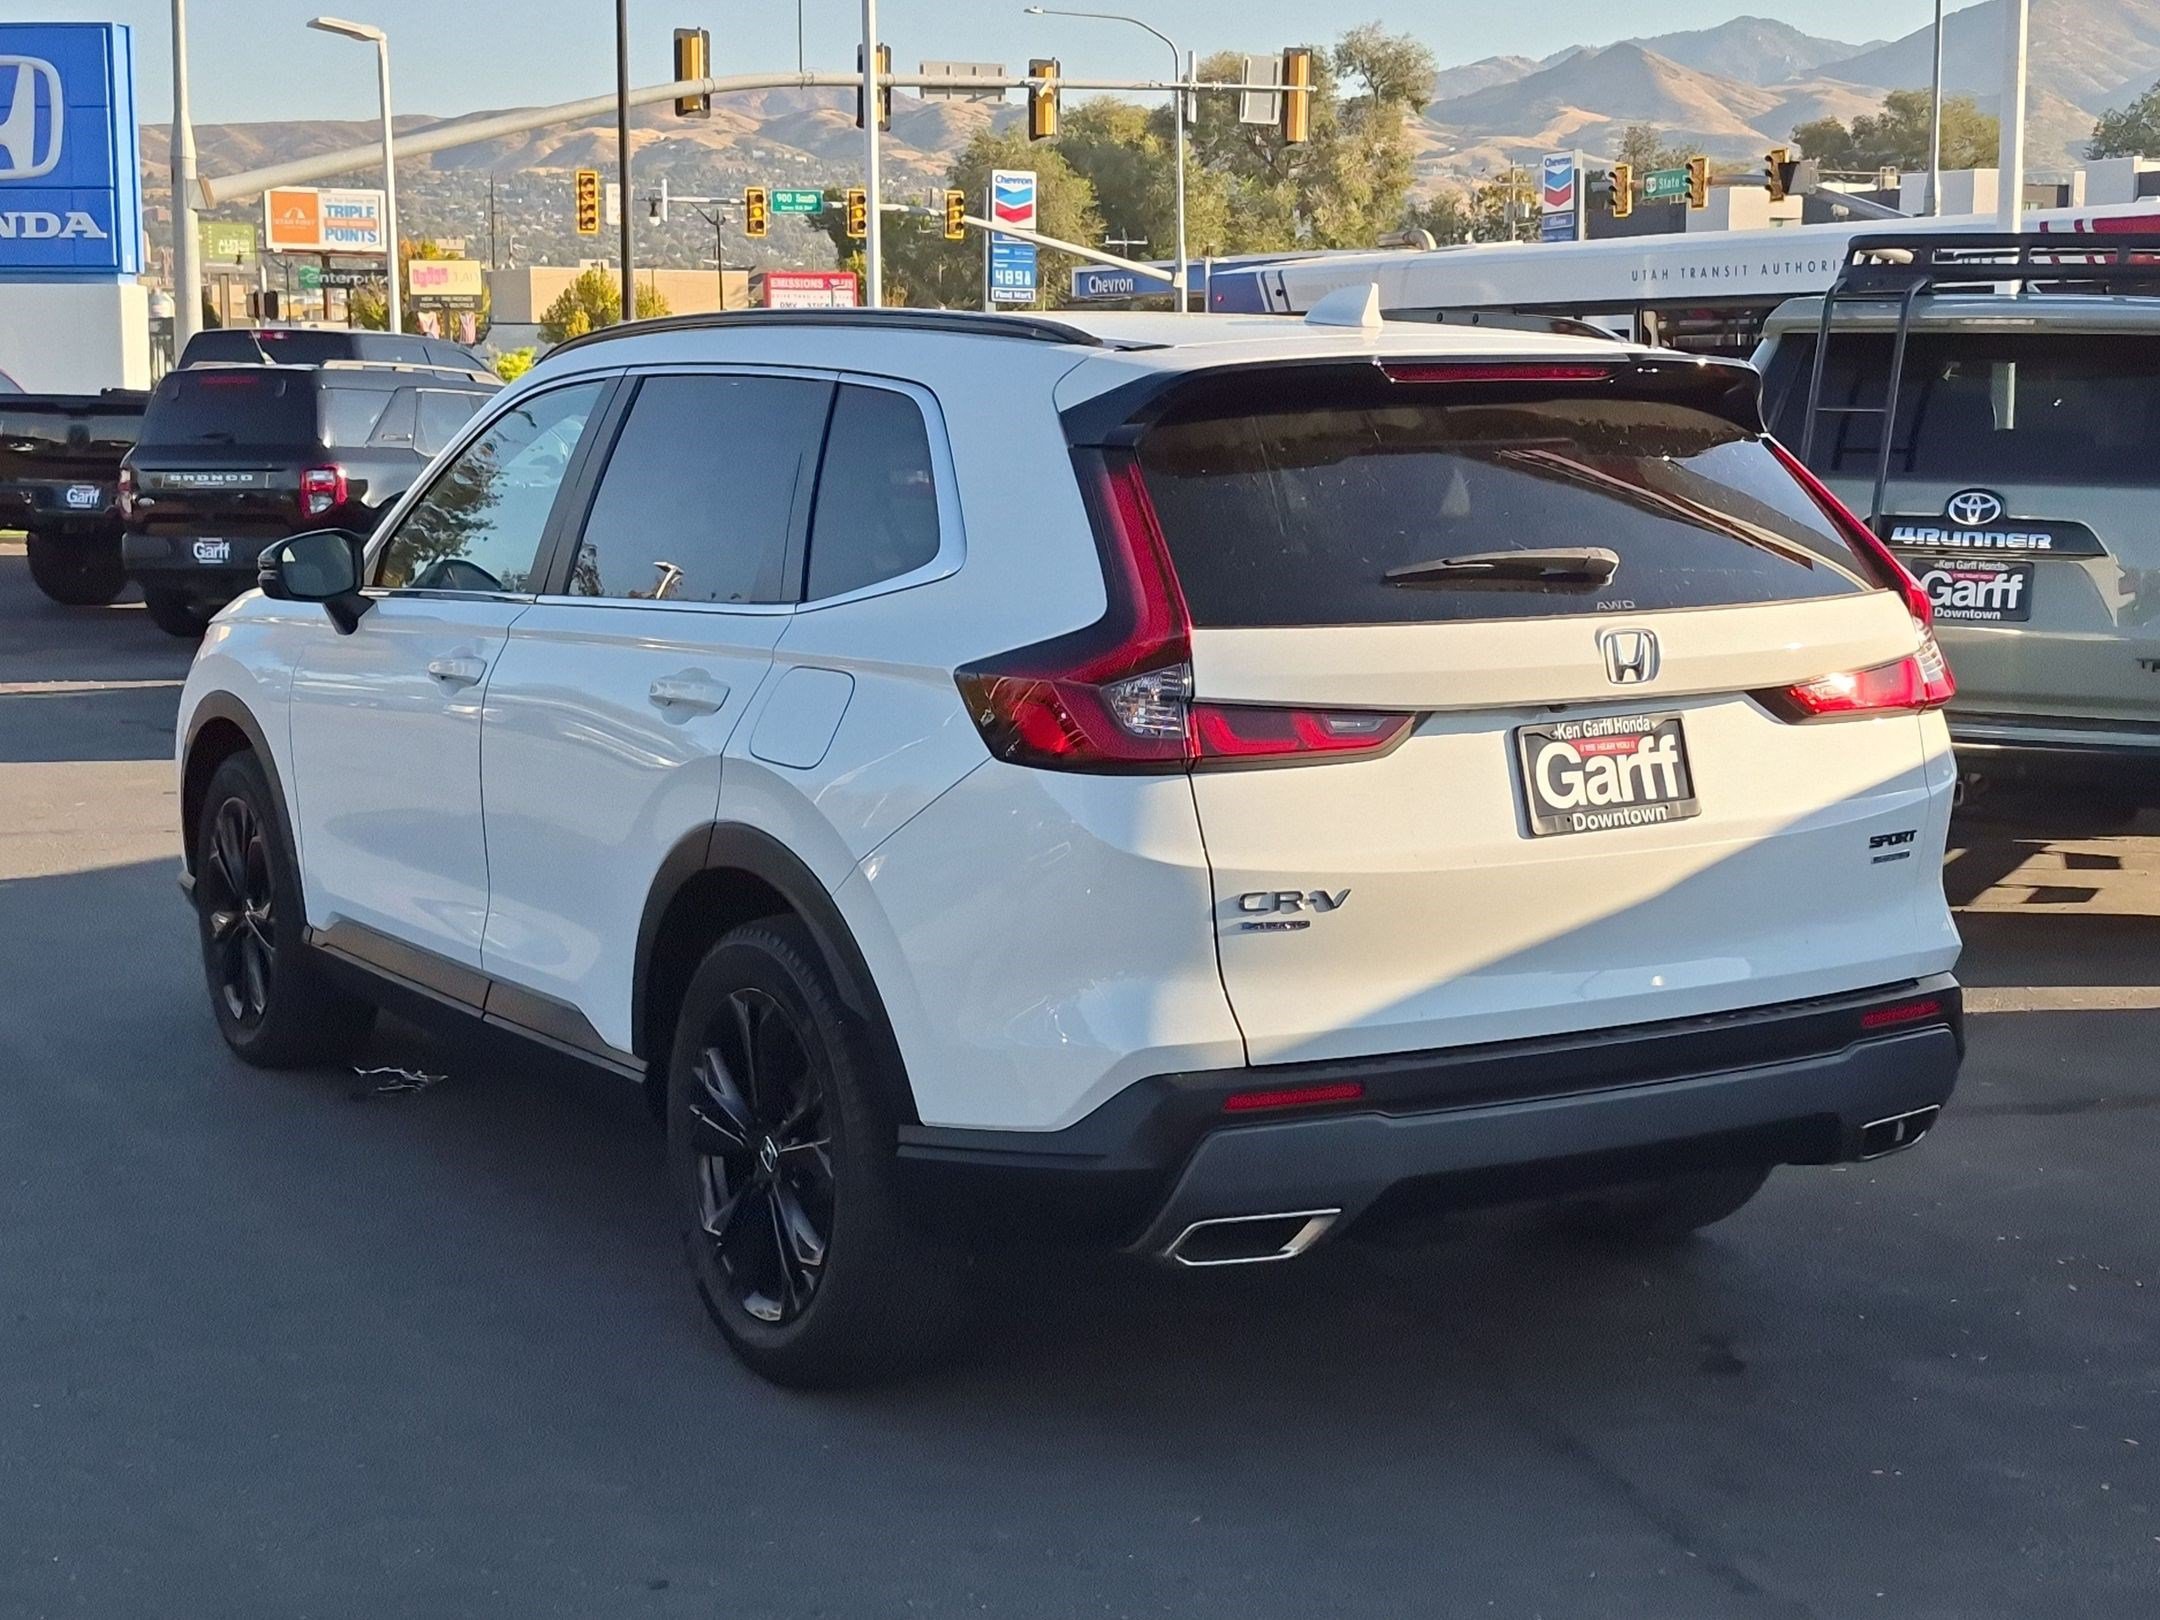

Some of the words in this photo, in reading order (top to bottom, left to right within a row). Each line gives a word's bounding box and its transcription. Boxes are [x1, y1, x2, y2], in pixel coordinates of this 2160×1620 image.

[995, 175, 1033, 185] Chevron
[1659, 177, 1680, 190] State
[776, 193, 793, 203] 900
[324, 205, 375, 218] TRIPLE
[324, 228, 377, 243] POINTS
[1631, 269, 1669, 281] UTAH
[1680, 264, 1749, 279] TRANSIT
[1760, 259, 1844, 276] AUTHORI
[770, 278, 824, 289] EMISSIONS
[1088, 275, 1134, 294] Chevron
[193, 542, 230, 559] Garff
[1938, 560, 1955, 570] Ken
[1956, 560, 1977, 570] Garff
[1921, 570, 2023, 609] Garff
[1597, 600, 1636, 610] AWD
[1934, 607, 2001, 620] Downtown
[1556, 723, 1581, 740] Ken
[1583, 718, 1613, 738] Garff
[1614, 716, 1651, 734] Honda
[1536, 734, 1679, 809] Garff
[1573, 806, 1668, 831] Downtown
[1869, 829, 1917, 849] SPORT
[1239, 888, 1351, 913] CR-V
